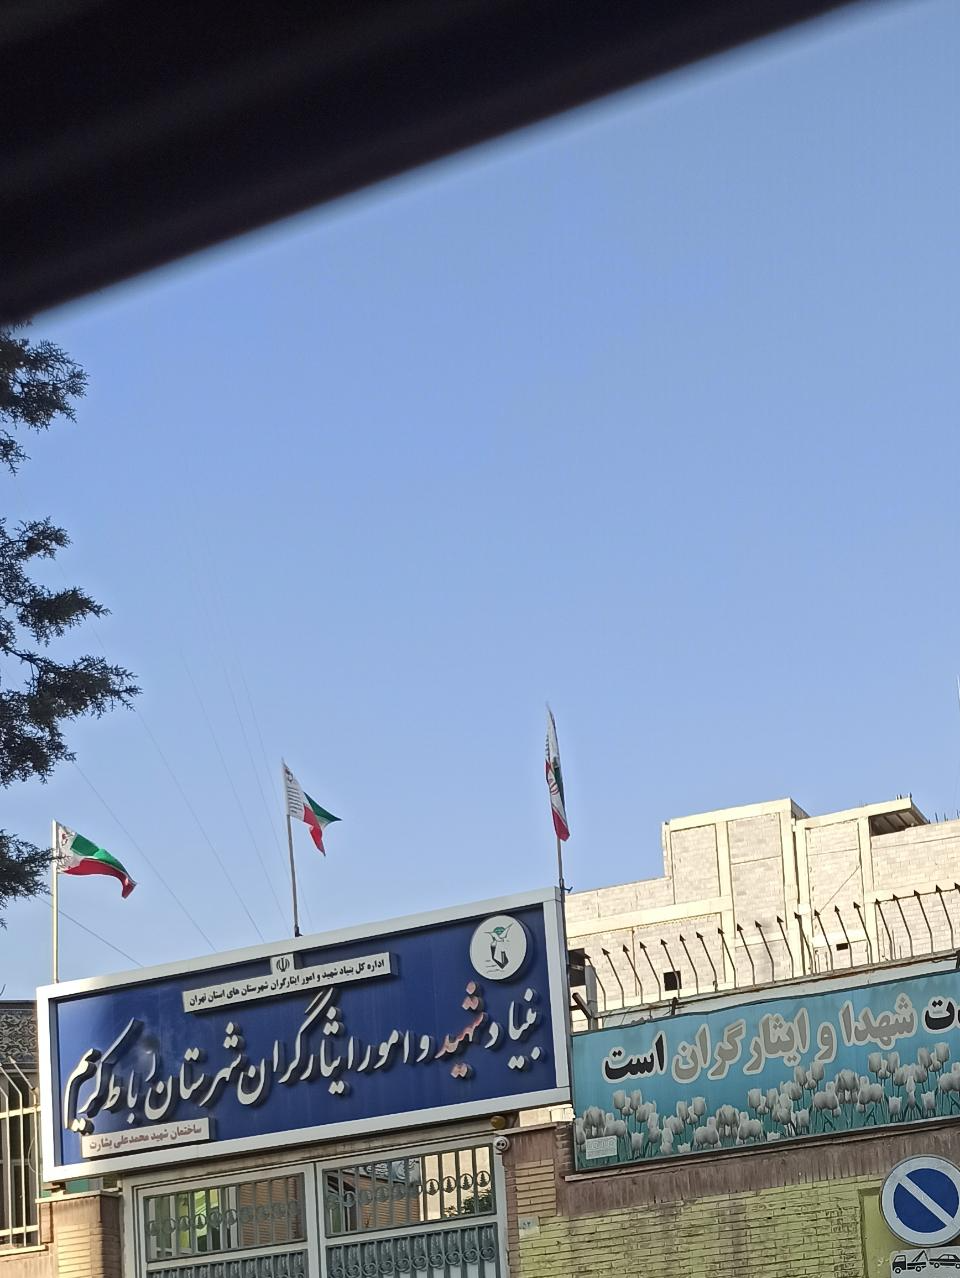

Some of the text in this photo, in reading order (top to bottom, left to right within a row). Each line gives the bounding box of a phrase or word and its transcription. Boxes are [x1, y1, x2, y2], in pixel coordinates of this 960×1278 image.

[322, 967, 338, 979] شهید
[339, 966, 354, 977] بنیاد
[356, 962, 366, 974] کل
[367, 959, 385, 971] اداره
[301, 973, 315, 985] امور
[189, 993, 207, 1007] تهران
[208, 990, 226, 1003] استان
[436, 981, 484, 1078] شهید
[485, 988, 541, 1069] بنیاد
[841, 997, 915, 1047] شهدا
[357, 1029, 410, 1072] امور
[416, 1034, 431, 1062] و
[818, 1025, 834, 1061] و
[605, 1034, 665, 1080] است
[64, 1017, 135, 1132] کریم
[145, 1021, 241, 1121] شهرستان
[150, 1128, 169, 1141] شهید
[170, 1124, 202, 1139] ساختمان
